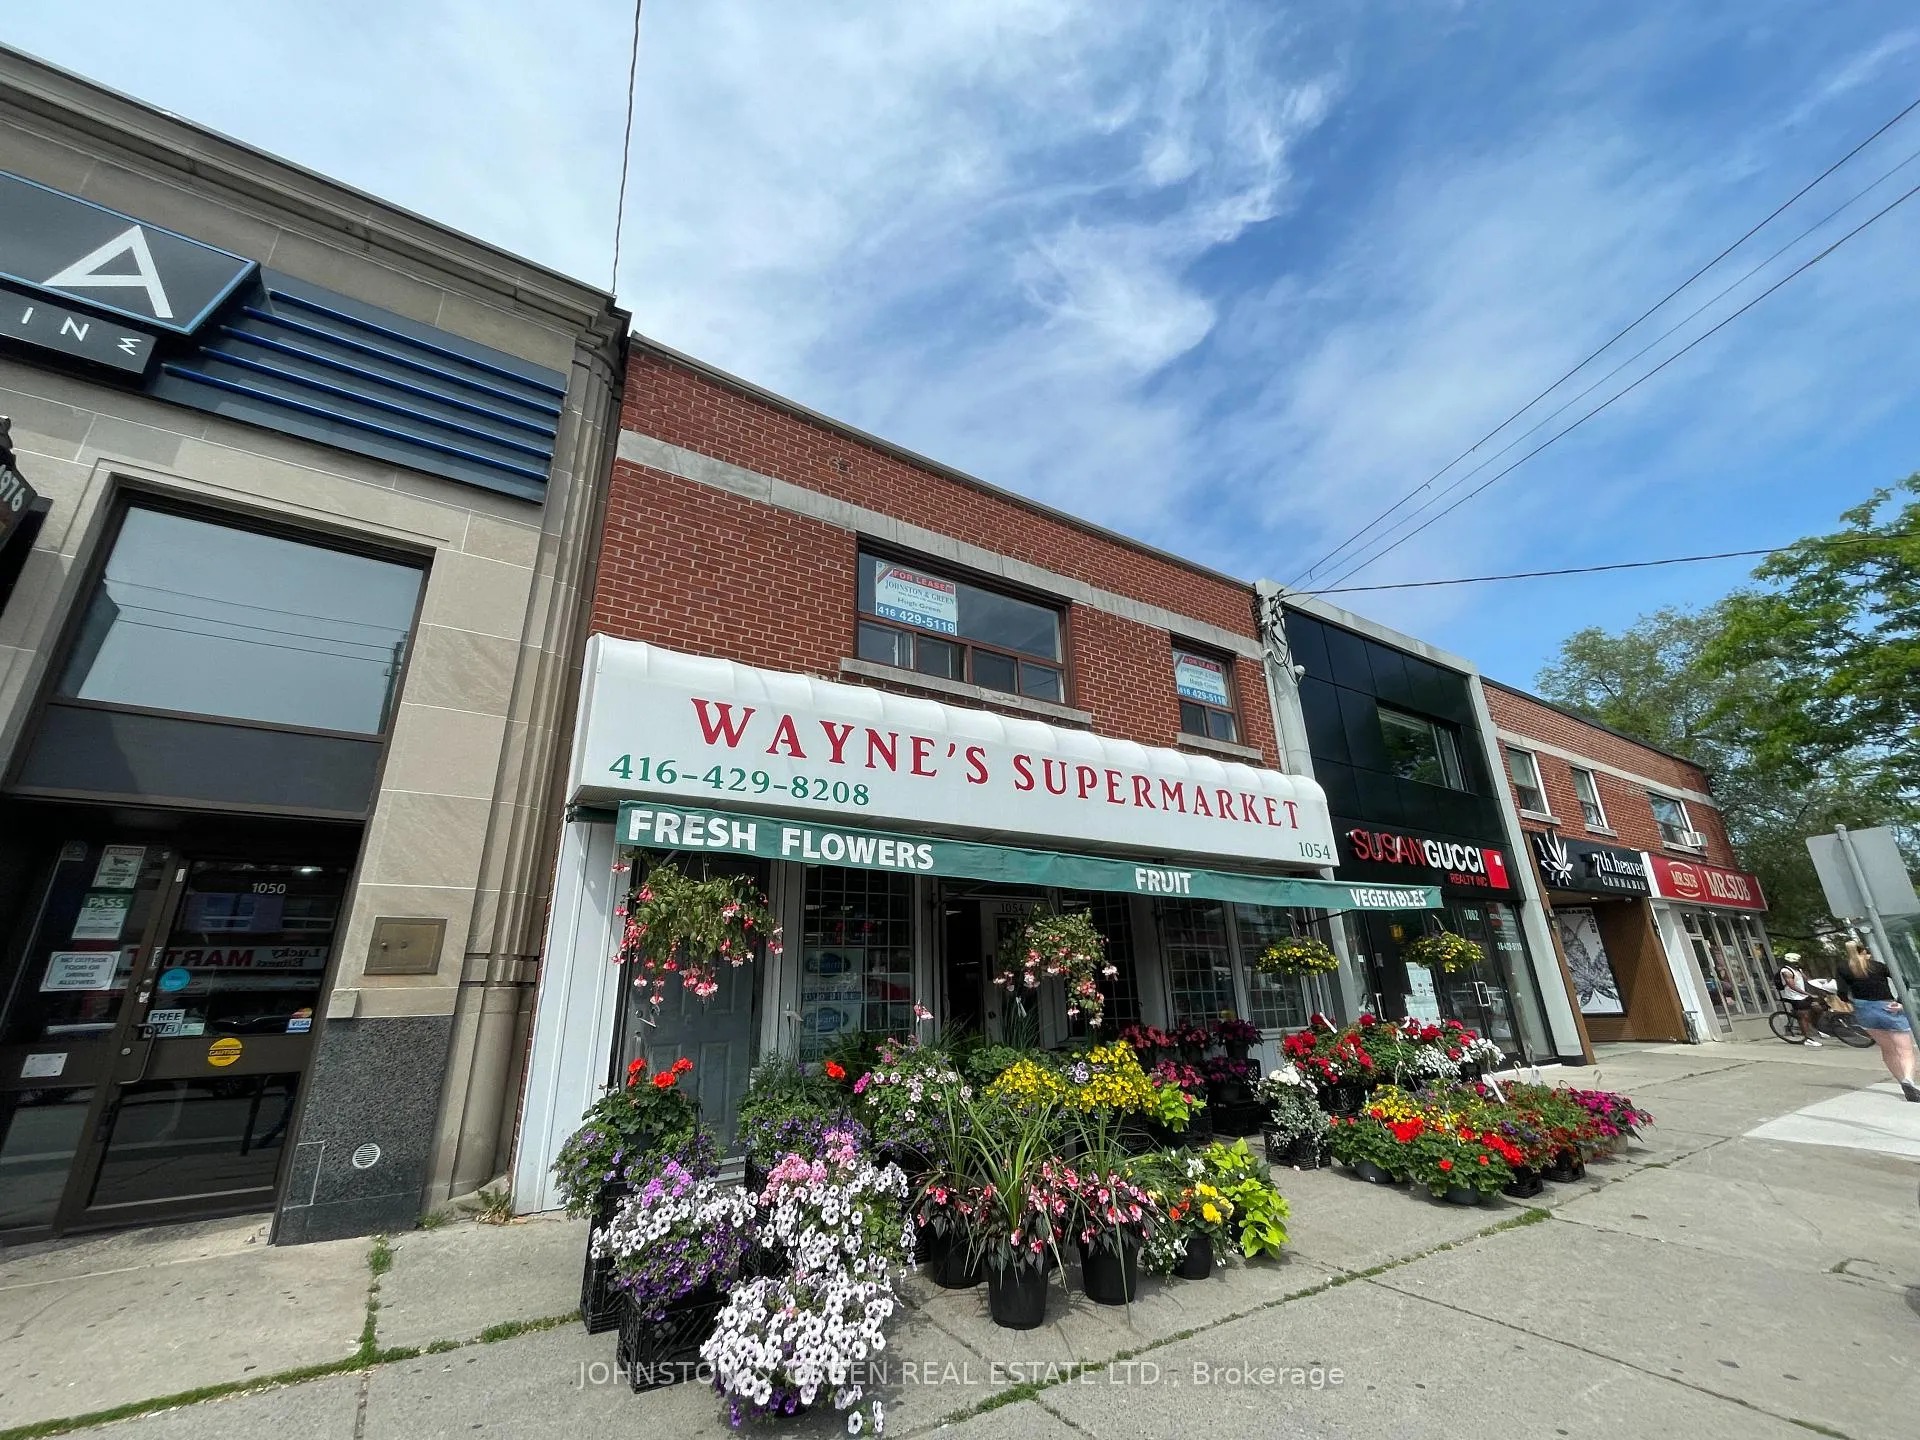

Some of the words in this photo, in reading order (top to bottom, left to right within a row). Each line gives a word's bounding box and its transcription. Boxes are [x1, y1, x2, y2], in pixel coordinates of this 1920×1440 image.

[893, 569, 913, 581] FOR
[916, 577, 946, 591] LEASE
[878, 606, 896, 616] 416
[900, 610, 955, 633] 429-5118
[690, 697, 990, 785] WAYNE'S
[1013, 753, 1300, 830] SUPERMARKET
[608, 753, 870, 806] 416-429-8208
[628, 809, 757, 851] FRESH
[781, 827, 935, 870] FLOWERS
[1298, 841, 1331, 860] 1054
[251, 882, 287, 895] 1050
[1135, 867, 1193, 895] FRUIT
[1450, 872, 1476, 886] REALTY
[1602, 875, 1646, 891] CANNABIS
[88, 897, 125, 908] PASS
[1350, 887, 1428, 908] VEGETABLES
[150, 1012, 183, 1022] FREE
